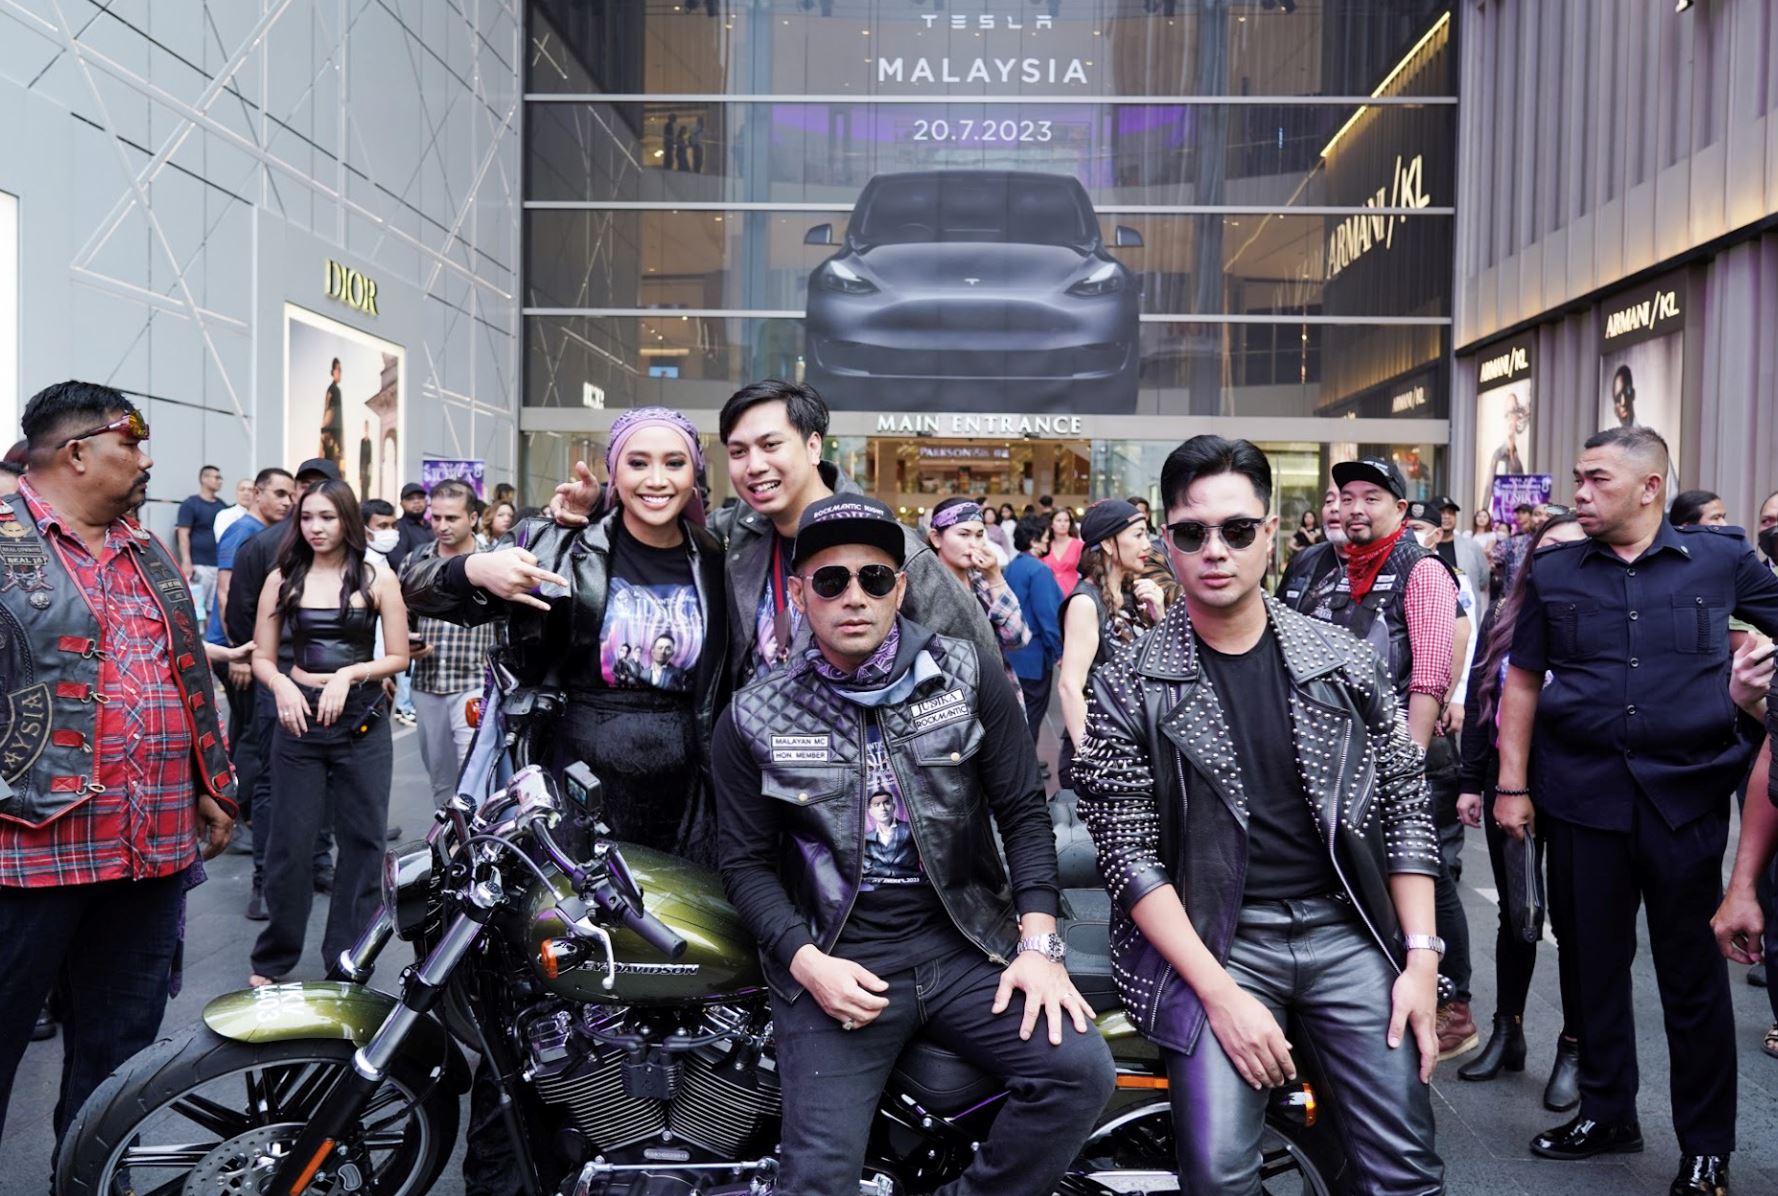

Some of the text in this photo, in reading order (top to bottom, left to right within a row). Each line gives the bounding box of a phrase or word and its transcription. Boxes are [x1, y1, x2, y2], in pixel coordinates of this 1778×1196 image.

[921, 14, 1052, 29] TESLA
[878, 57, 1088, 83] MALAYSIA
[913, 119, 1052, 141] 20.7.2023
[324, 258, 379, 316] DIOR
[1605, 290, 1680, 340] ARMANI/KL
[876, 414, 1082, 434] MAIN ENTRANCE
[916, 705, 968, 727] ROCKMANTIC
[0, 692, 44, 775] AYSIA
